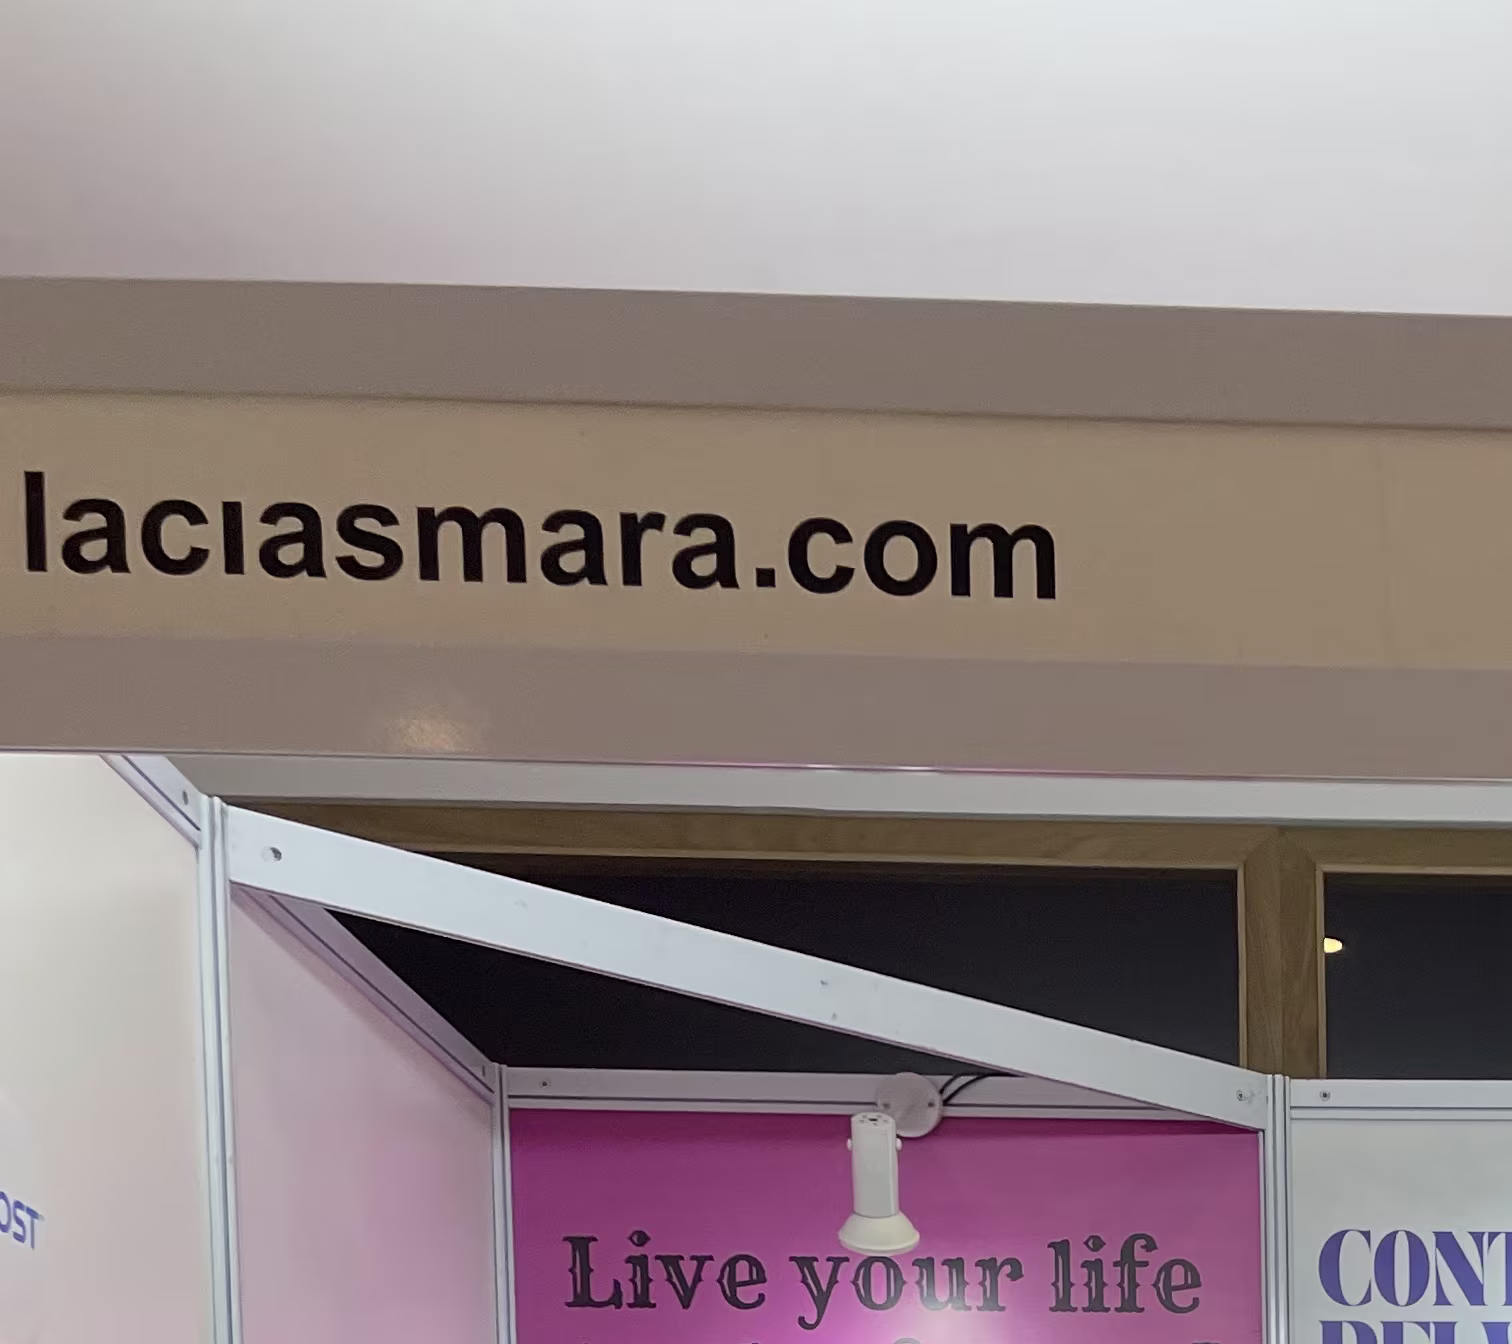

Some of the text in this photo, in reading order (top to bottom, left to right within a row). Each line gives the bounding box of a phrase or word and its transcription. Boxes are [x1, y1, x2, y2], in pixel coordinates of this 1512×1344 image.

[562, 1230, 1203, 1331] Live your life
